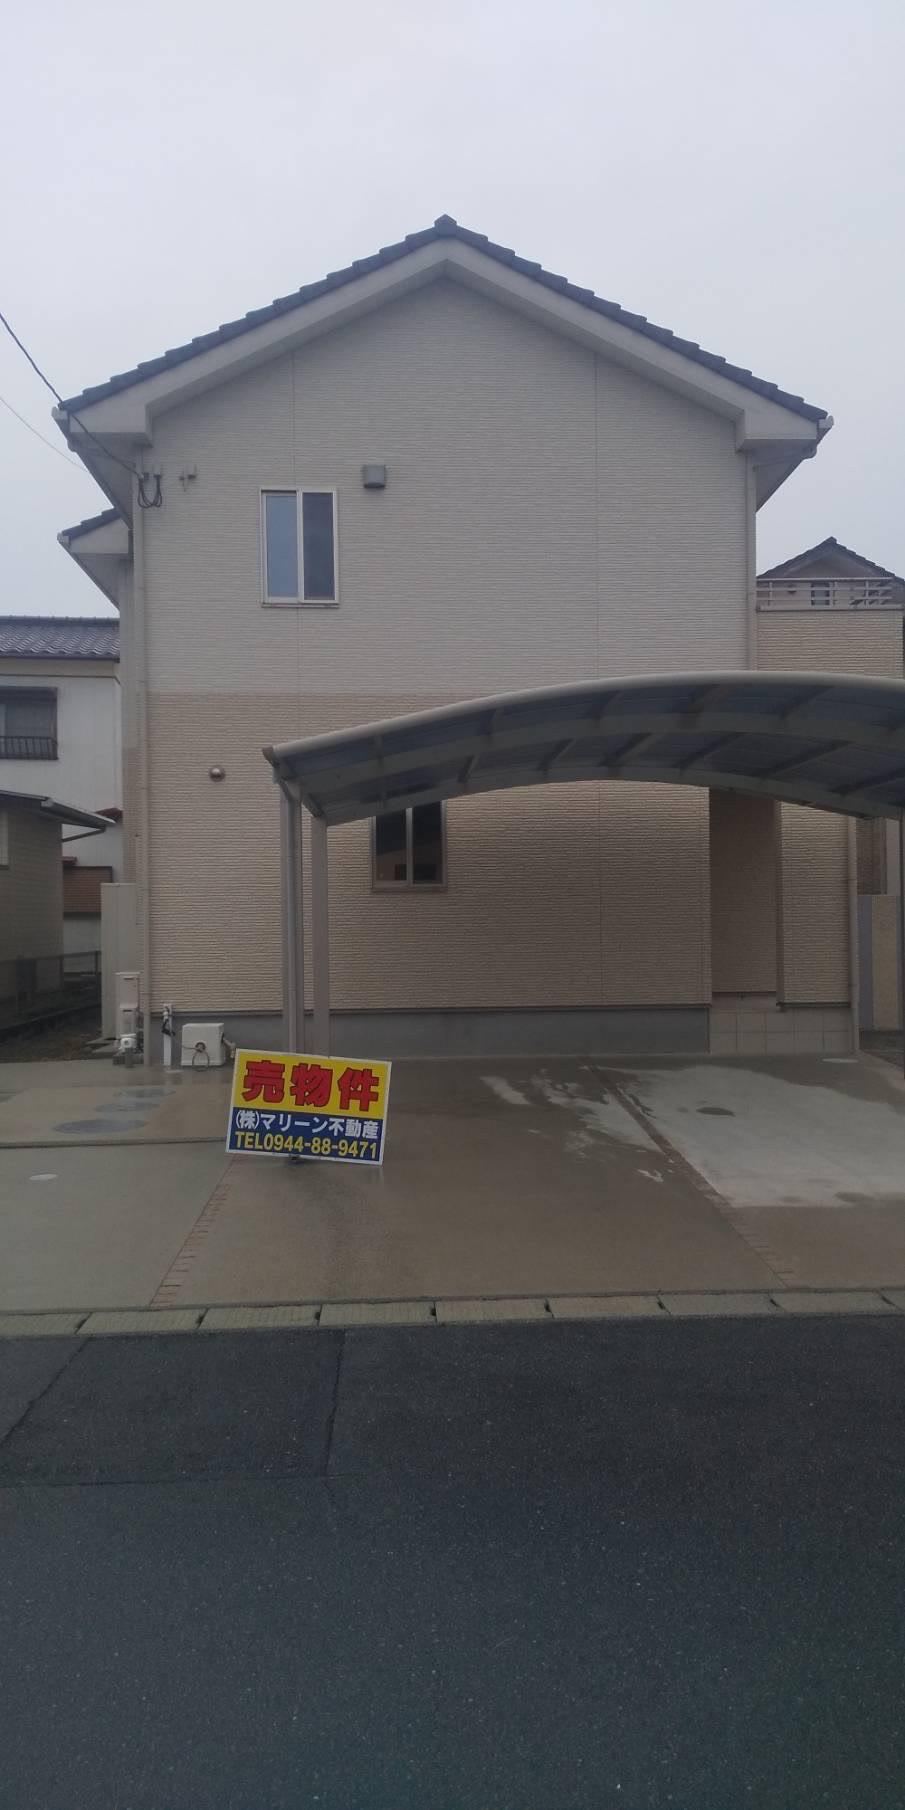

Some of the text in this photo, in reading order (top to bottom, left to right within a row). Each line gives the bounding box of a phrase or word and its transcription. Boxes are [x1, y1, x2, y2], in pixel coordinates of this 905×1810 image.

[242, 1060, 379, 1111] 売物件
[236, 1110, 379, 1139] (株)マリーン不動産
[235, 1132, 377, 1159] TEL0944-88-9471
